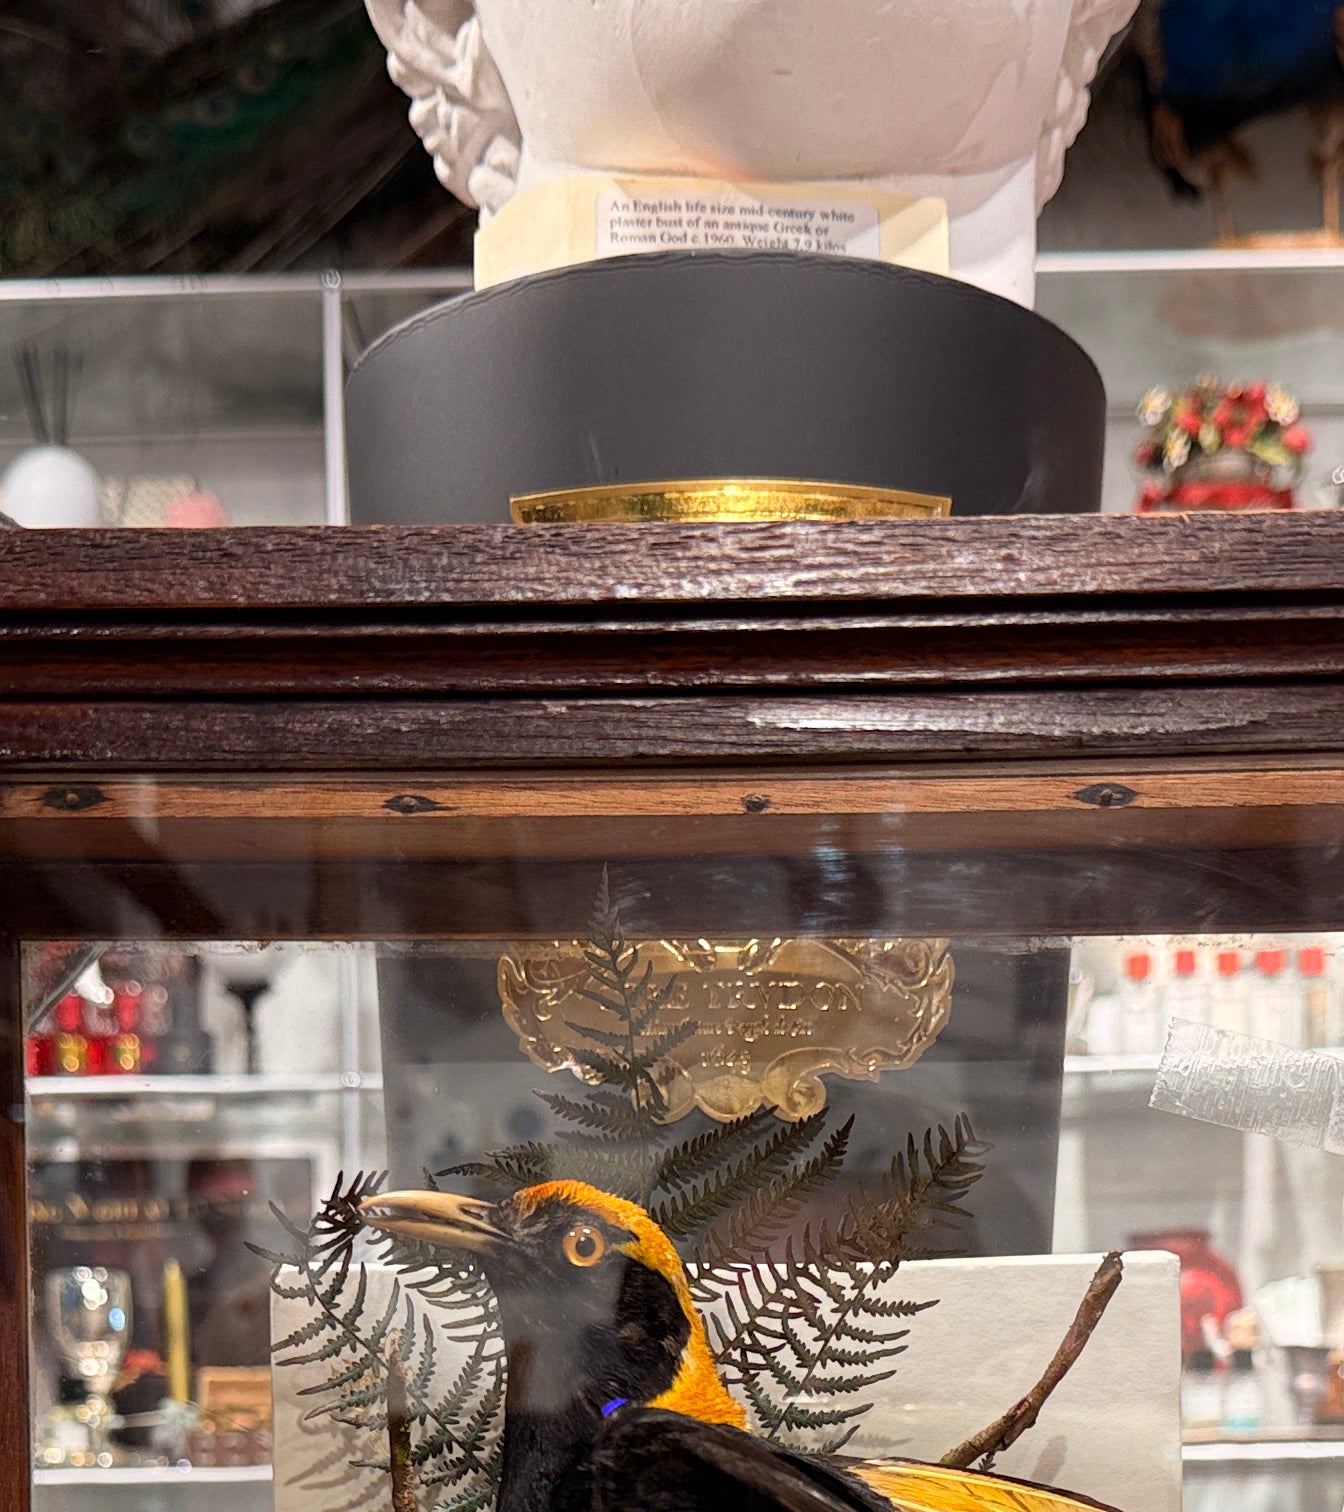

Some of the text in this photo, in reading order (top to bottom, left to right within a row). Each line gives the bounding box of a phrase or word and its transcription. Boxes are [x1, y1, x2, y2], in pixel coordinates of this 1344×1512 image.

[610, 200, 630, 213] An
[633, 199, 682, 215] English
[685, 200, 707, 214] life
[709, 201, 736, 216] size
[819, 208, 855, 223] white
[609, 216, 830, 238] plaster bust of an antique Greek or
[609, 231, 656, 244] Roman
[659, 230, 688, 244] God
